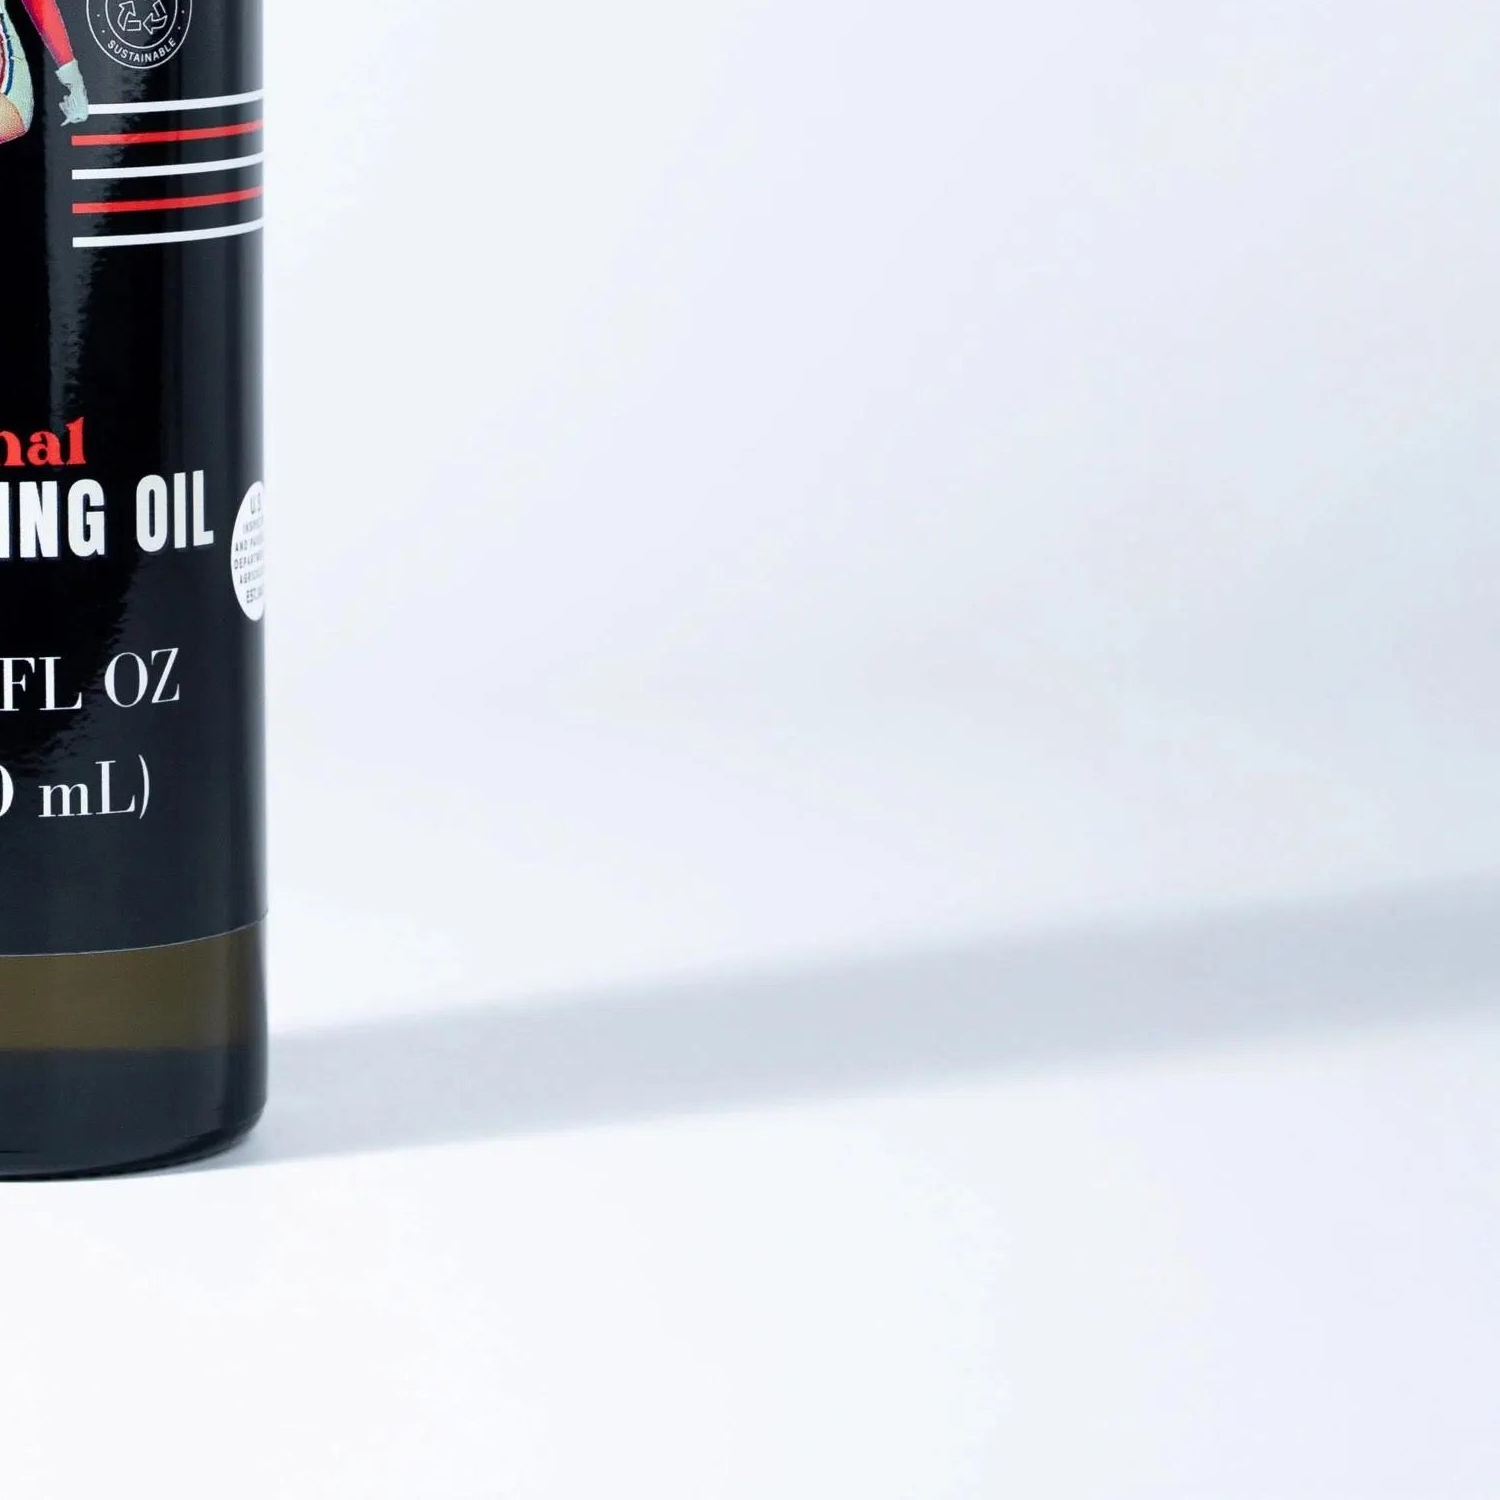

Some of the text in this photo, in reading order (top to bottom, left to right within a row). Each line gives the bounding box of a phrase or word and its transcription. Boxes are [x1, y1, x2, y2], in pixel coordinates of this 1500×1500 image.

[107, 38, 176, 63] SUSTAINABLE
[135, 469, 215, 554] OIL
[104, 647, 180, 708] OZ
[38, 754, 150, 819] mL)
